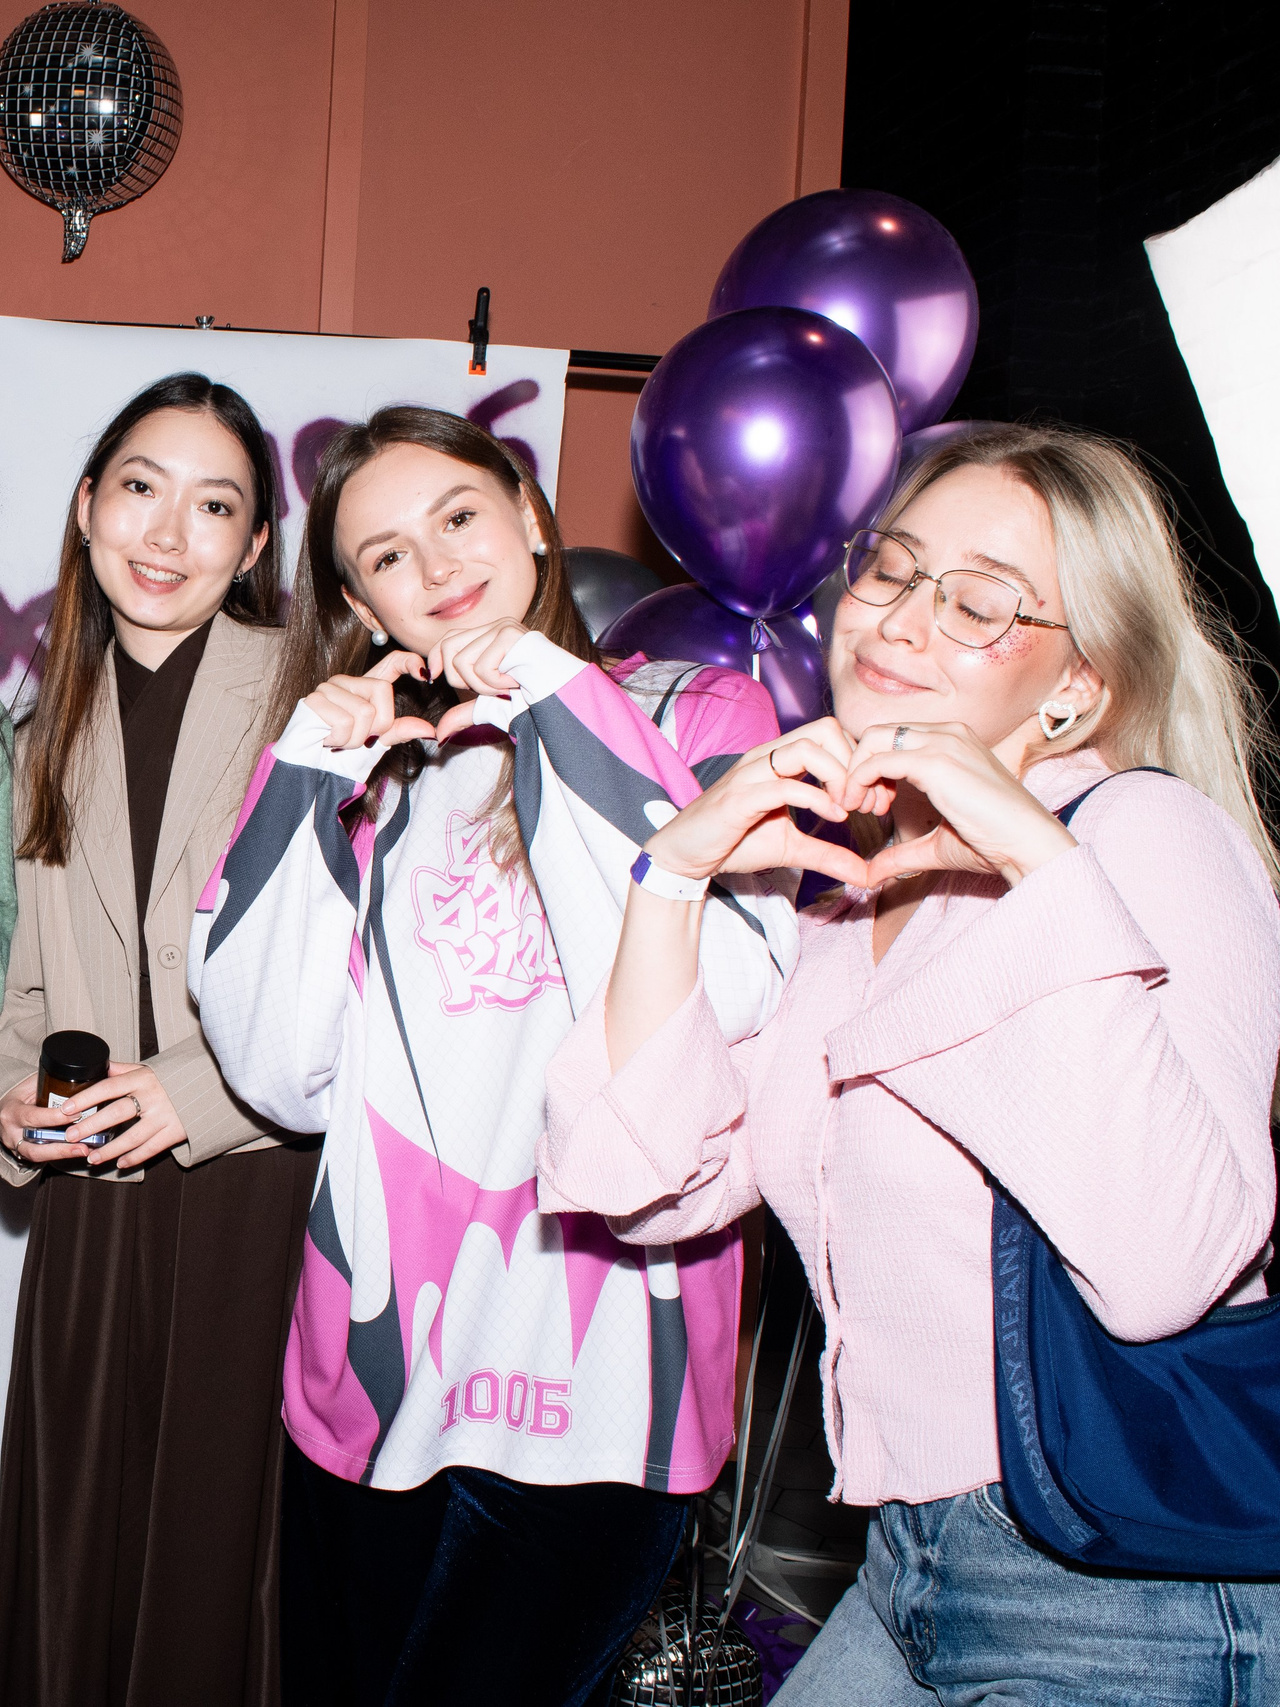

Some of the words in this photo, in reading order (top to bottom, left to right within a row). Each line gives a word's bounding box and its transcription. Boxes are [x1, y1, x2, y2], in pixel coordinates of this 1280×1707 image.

[998, 1222, 1022, 1347] JEANS
[438, 1367, 573, 1439] 100Б
[1005, 1358, 1052, 1505] TOMMY
